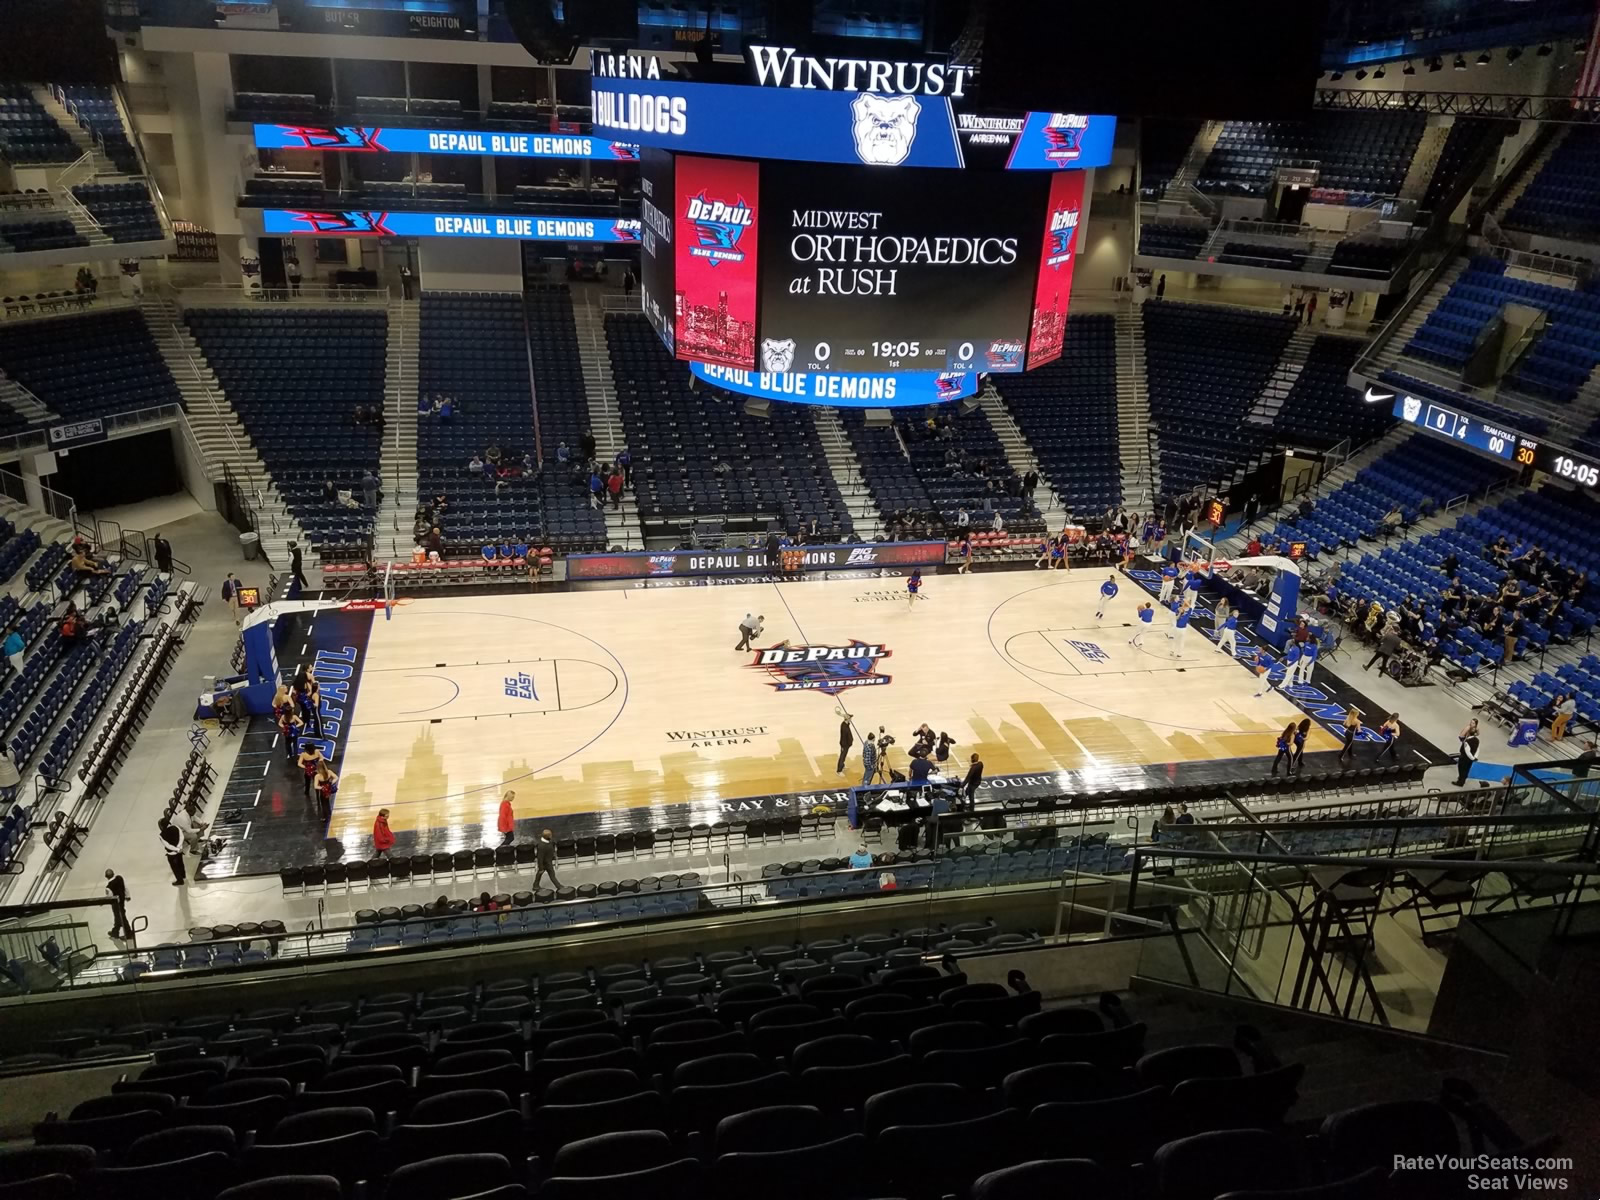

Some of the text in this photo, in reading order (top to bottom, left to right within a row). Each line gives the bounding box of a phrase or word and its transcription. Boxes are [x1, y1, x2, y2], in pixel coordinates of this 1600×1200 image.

[324, 12, 360, 24] BUTER
[600, 54, 661, 80] ARENA
[749, 45, 974, 97] WINTRUST
[598, 90, 687, 135] BULLDOGS
[958, 114, 1025, 130] WINTRUST
[429, 133, 592, 155] DEPAUL BLUE DEMONS
[687, 199, 753, 226] DEPAUL
[792, 210, 882, 229] MIDWEST
[1051, 210, 1079, 231] DEPAUL
[435, 217, 594, 237] DEPAUL BLUE DEMONS
[617, 219, 641, 230] DEPA
[791, 234, 1018, 264] ORTHOPAEDICS
[789, 268, 898, 295] at RUSH
[814, 342, 831, 361] 0
[872, 341, 920, 357] 19:05
[958, 342, 974, 361] 0
[990, 343, 1023, 352] DEPAUL
[760, 372, 807, 395] BLUE
[815, 375, 897, 399] DEMONS
[1436, 413, 1446, 428] 0
[1460, 416, 1469, 424] TOL
[1457, 425, 1467, 439] 4
[1483, 425, 1516, 441] TEAM FOULS
[1489, 437, 1504, 453] 00
[1520, 439, 1537, 449] SHOT
[1518, 448, 1534, 464] 30
[1554, 456, 1599, 486] 19:05
[650, 555, 676, 563] DEPAUL
[690, 556, 740, 569] DEPAUL
[747, 555, 778, 567] BL
[848, 553, 878, 561] EAST
[635, 571, 903, 589] DEPAUL UNIVERSITY CHICAGO
[761, 646, 886, 665] DEPAUL
[1070, 640, 1104, 664] EAST
[1084, 642, 1110, 659] BIG
[504, 677, 518, 697] BIG
[519, 671, 532, 699] EAST
[784, 677, 884, 690] BLUE DEMONS
[666, 726, 768, 740] WINTRUST
[691, 738, 752, 748] ARENA
[978, 775, 1052, 789] COURT
[720, 799, 764, 813] RAY
[775, 798, 790, 807] &
